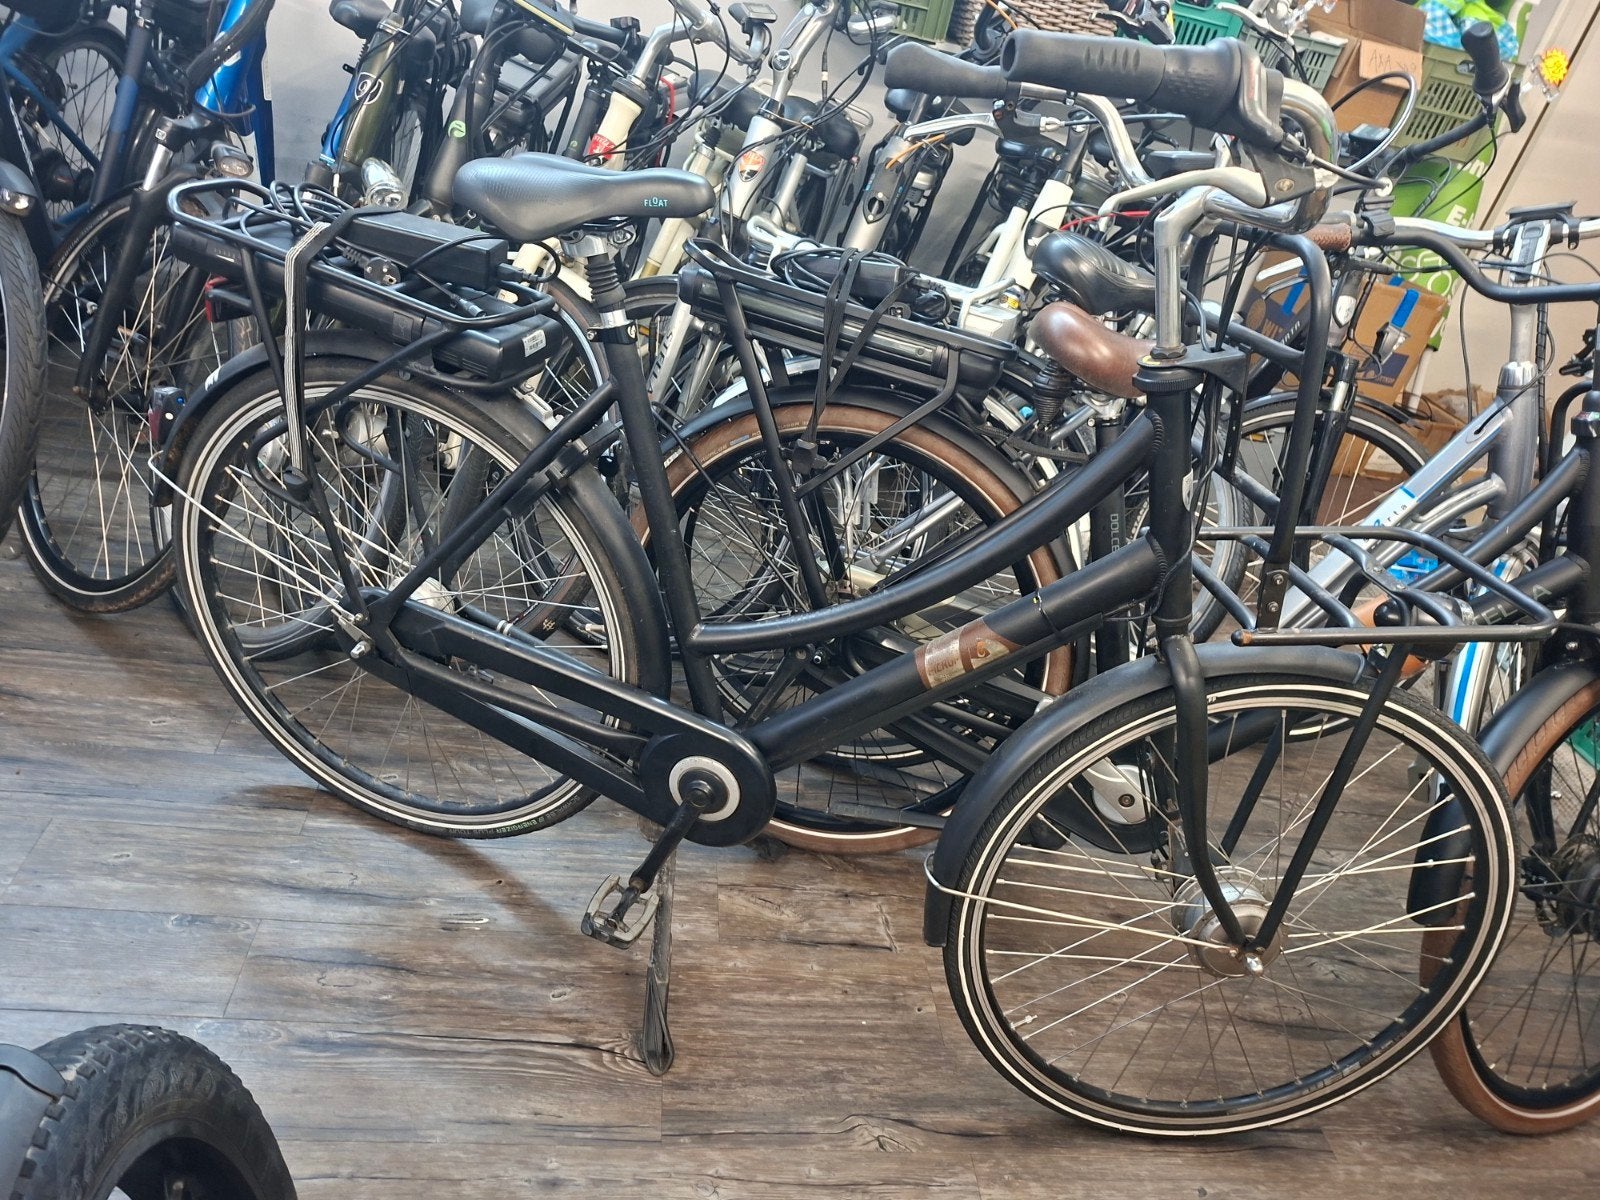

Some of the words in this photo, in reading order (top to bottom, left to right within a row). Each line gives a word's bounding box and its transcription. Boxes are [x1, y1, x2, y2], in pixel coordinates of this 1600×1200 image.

[643, 196, 669, 207] FLOAT
[1109, 513, 1121, 552] DOLCE
[496, 819, 538, 834] ENERGIZER
